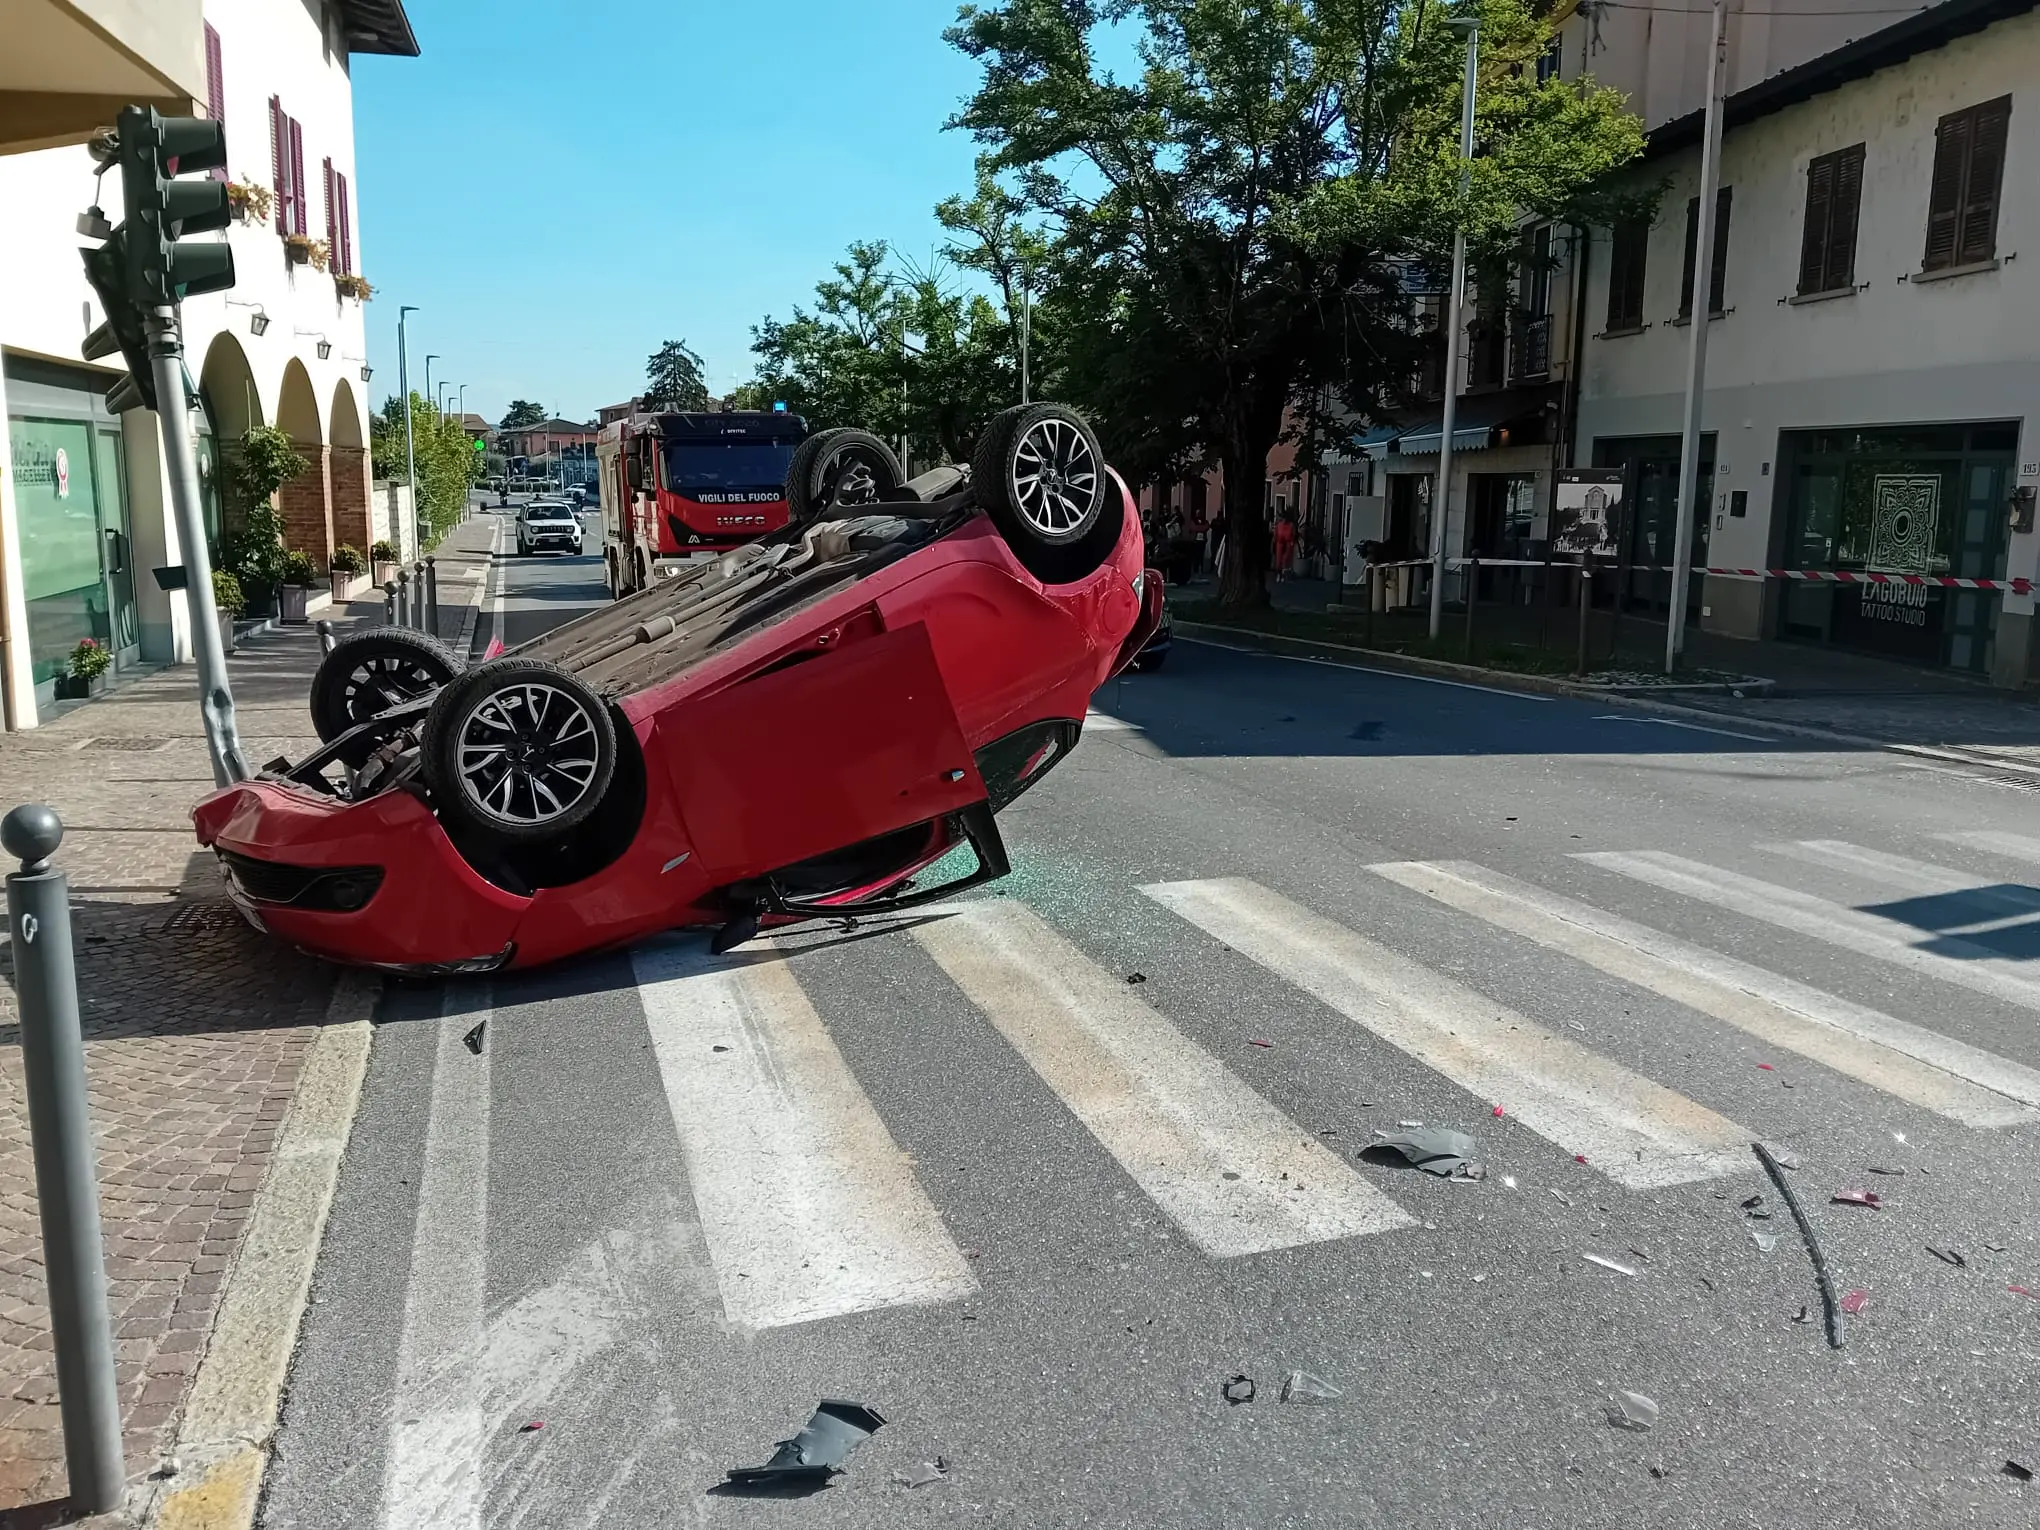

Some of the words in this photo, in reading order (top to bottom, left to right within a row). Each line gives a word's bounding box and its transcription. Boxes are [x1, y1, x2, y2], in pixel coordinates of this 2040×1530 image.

[698, 494, 725, 503] VIGILI
[728, 493, 747, 502] DEL
[748, 492, 780, 502] FUOCO
[716, 516, 766, 526] IVECO
[1861, 581, 1928, 608] LAGOBUIO
[1862, 602, 1894, 621] TATTOO
[1894, 606, 1925, 626] STUDIO
